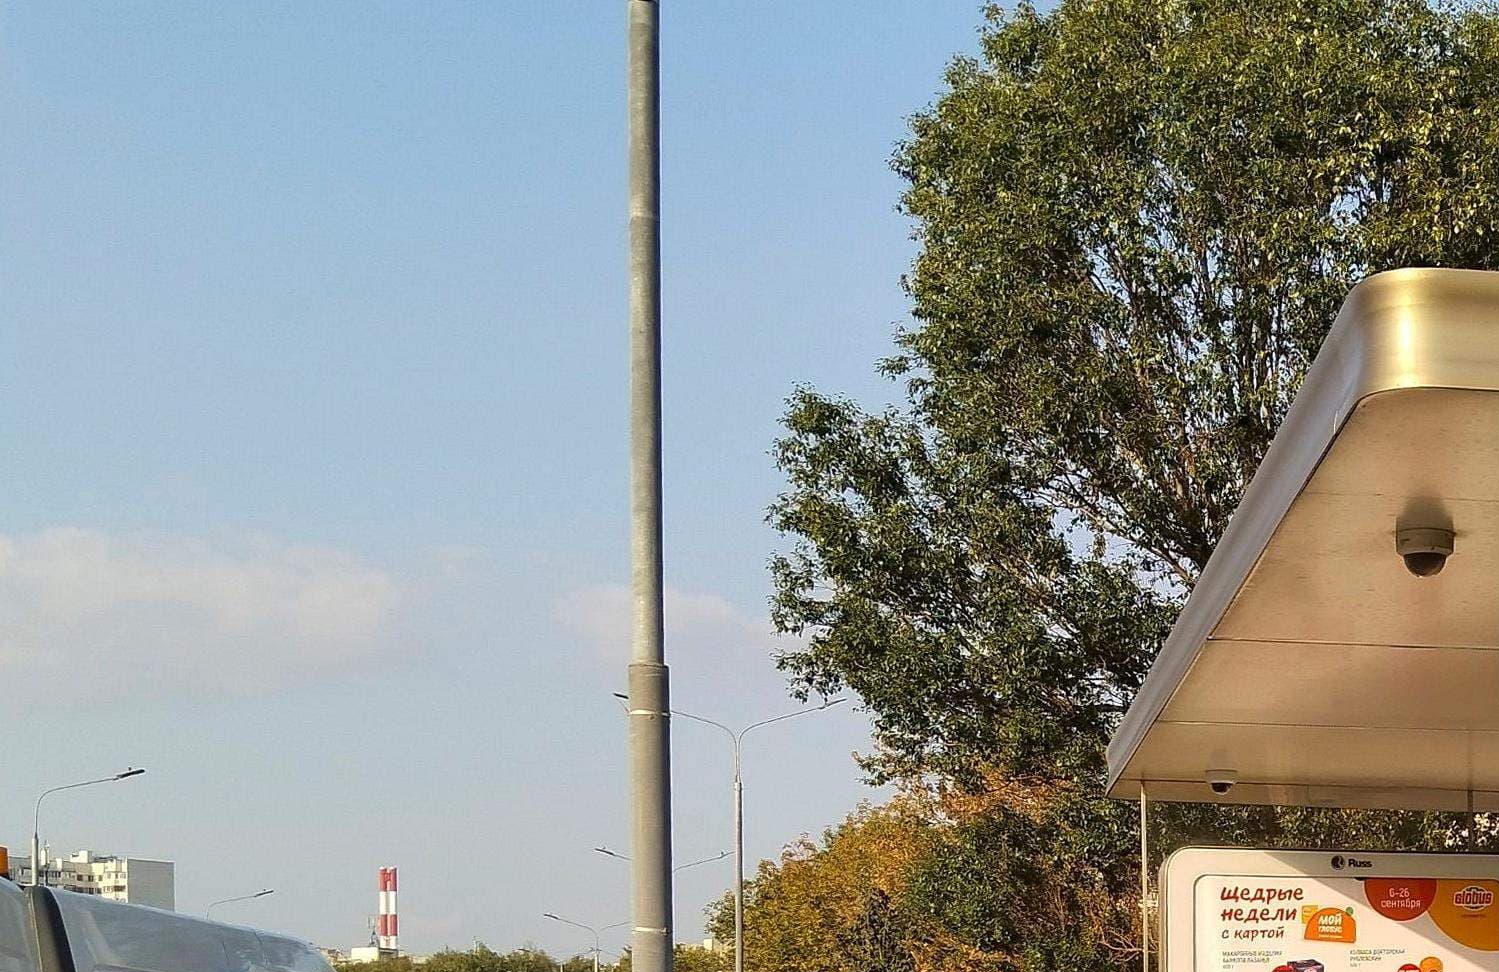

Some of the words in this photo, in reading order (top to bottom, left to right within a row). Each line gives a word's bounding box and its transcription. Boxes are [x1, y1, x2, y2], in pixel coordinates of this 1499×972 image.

[1348, 859, 1372, 868] Russ
[1220, 887, 1304, 904] Щедрые
[1380, 899, 1421, 909] сентября
[1221, 908, 1297, 923] недели
[1222, 929, 1229, 938] с
[1234, 926, 1284, 941] картой
